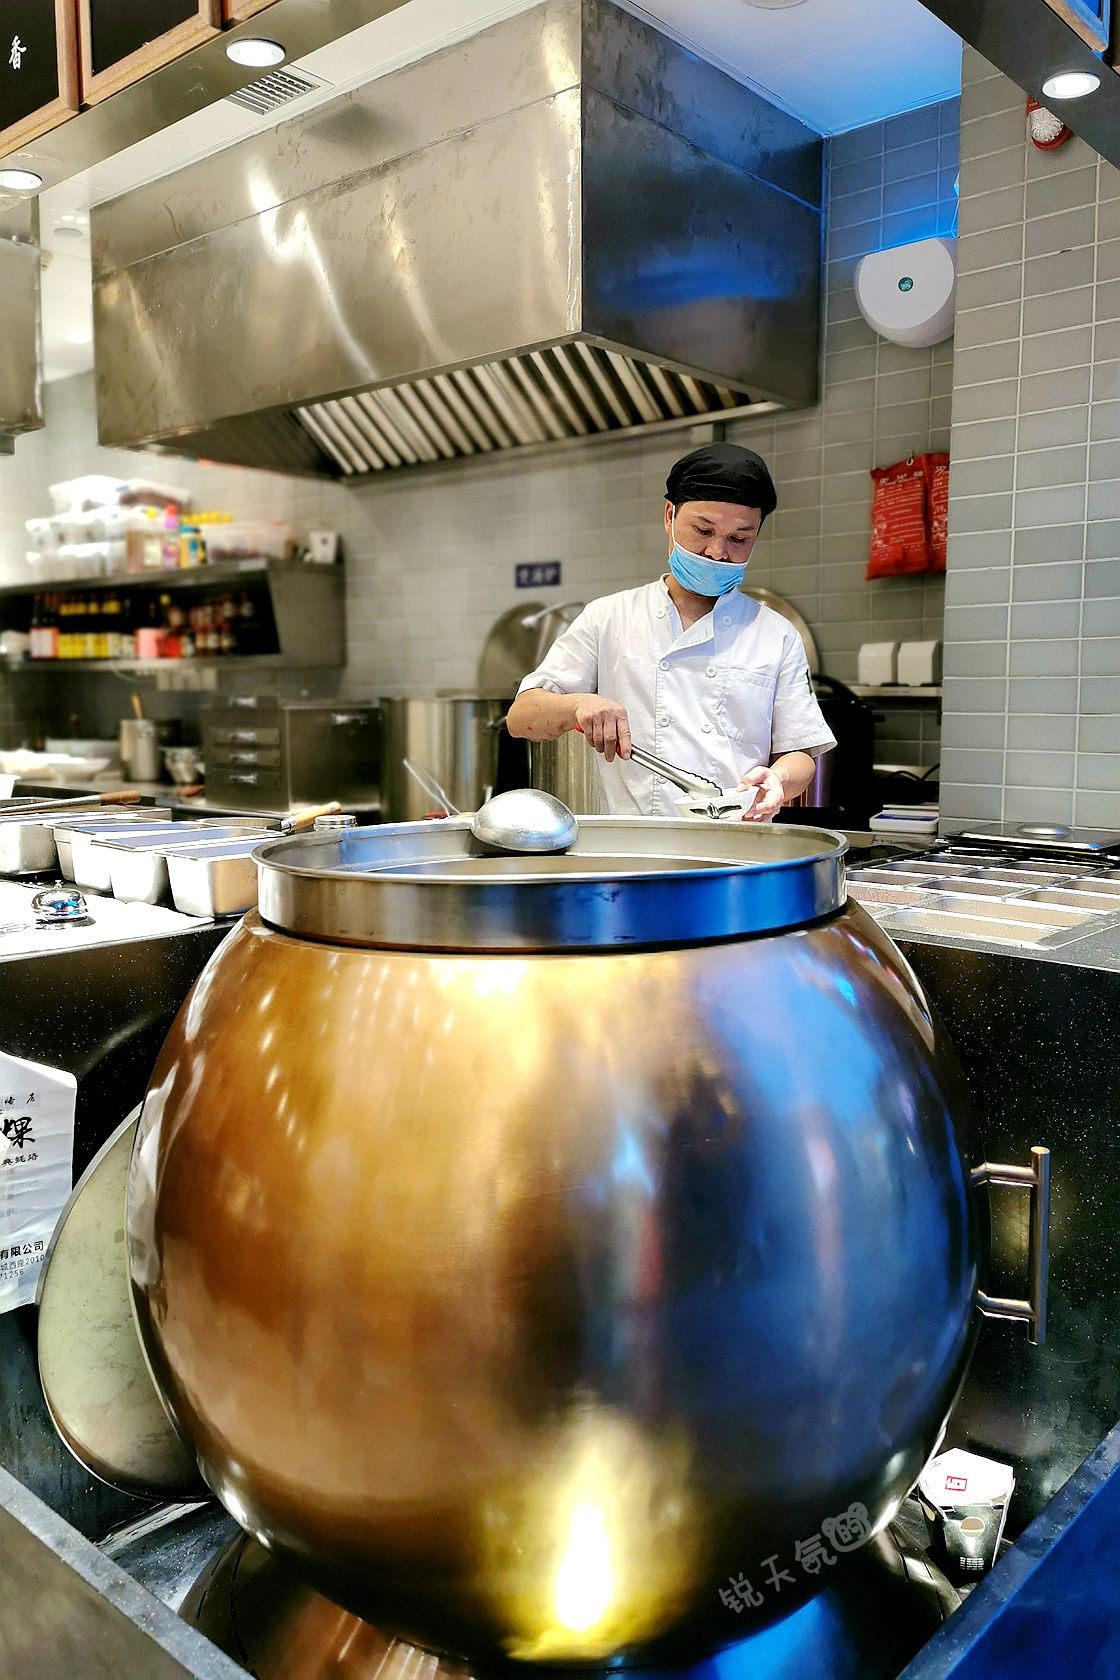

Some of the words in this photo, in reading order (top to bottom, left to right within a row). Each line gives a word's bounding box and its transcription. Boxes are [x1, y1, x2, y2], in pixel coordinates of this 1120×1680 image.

[8, 35, 27, 70] 香
[0, 1240, 44, 1260] 有限公司
